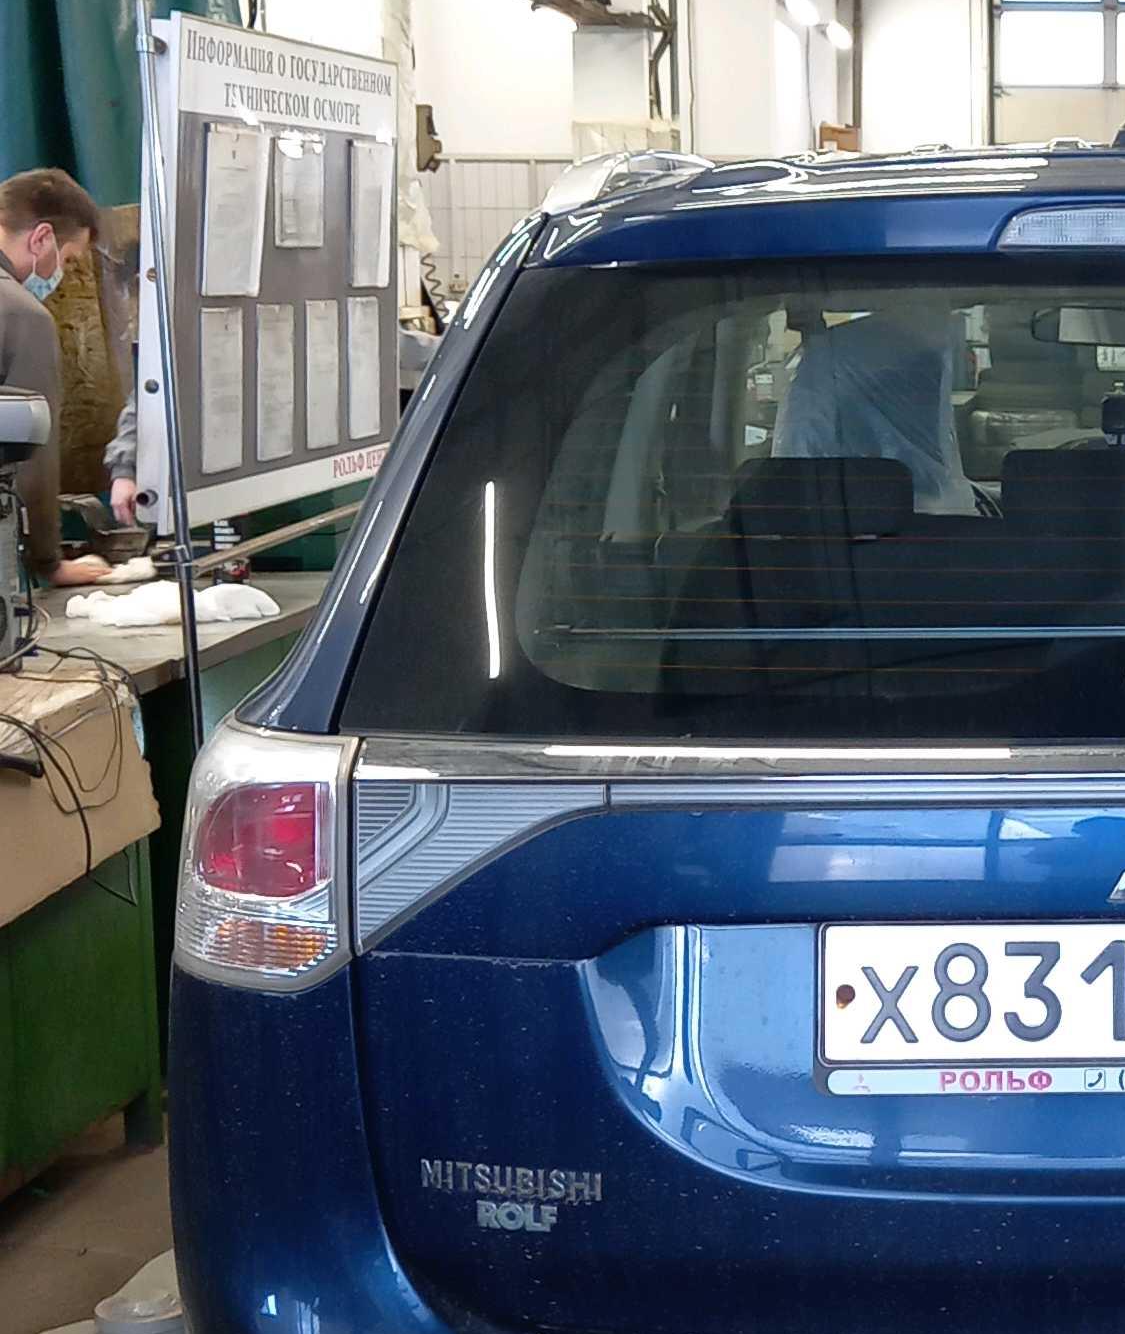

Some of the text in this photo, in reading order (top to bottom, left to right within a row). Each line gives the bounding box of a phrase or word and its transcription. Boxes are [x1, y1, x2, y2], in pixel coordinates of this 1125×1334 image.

[186, 29, 392, 97] ИНФОРМАЦИЯ О ГОСУДАРСТВЕННОМ
[224, 82, 361, 126] ТЕХНИЧЕСКОМ ОСМОТРЕ
[939, 1068, 1053, 1093] РОЛЬФ
[420, 1158, 602, 1202] MITSUBISHI
[476, 1200, 558, 1232] ROLF
